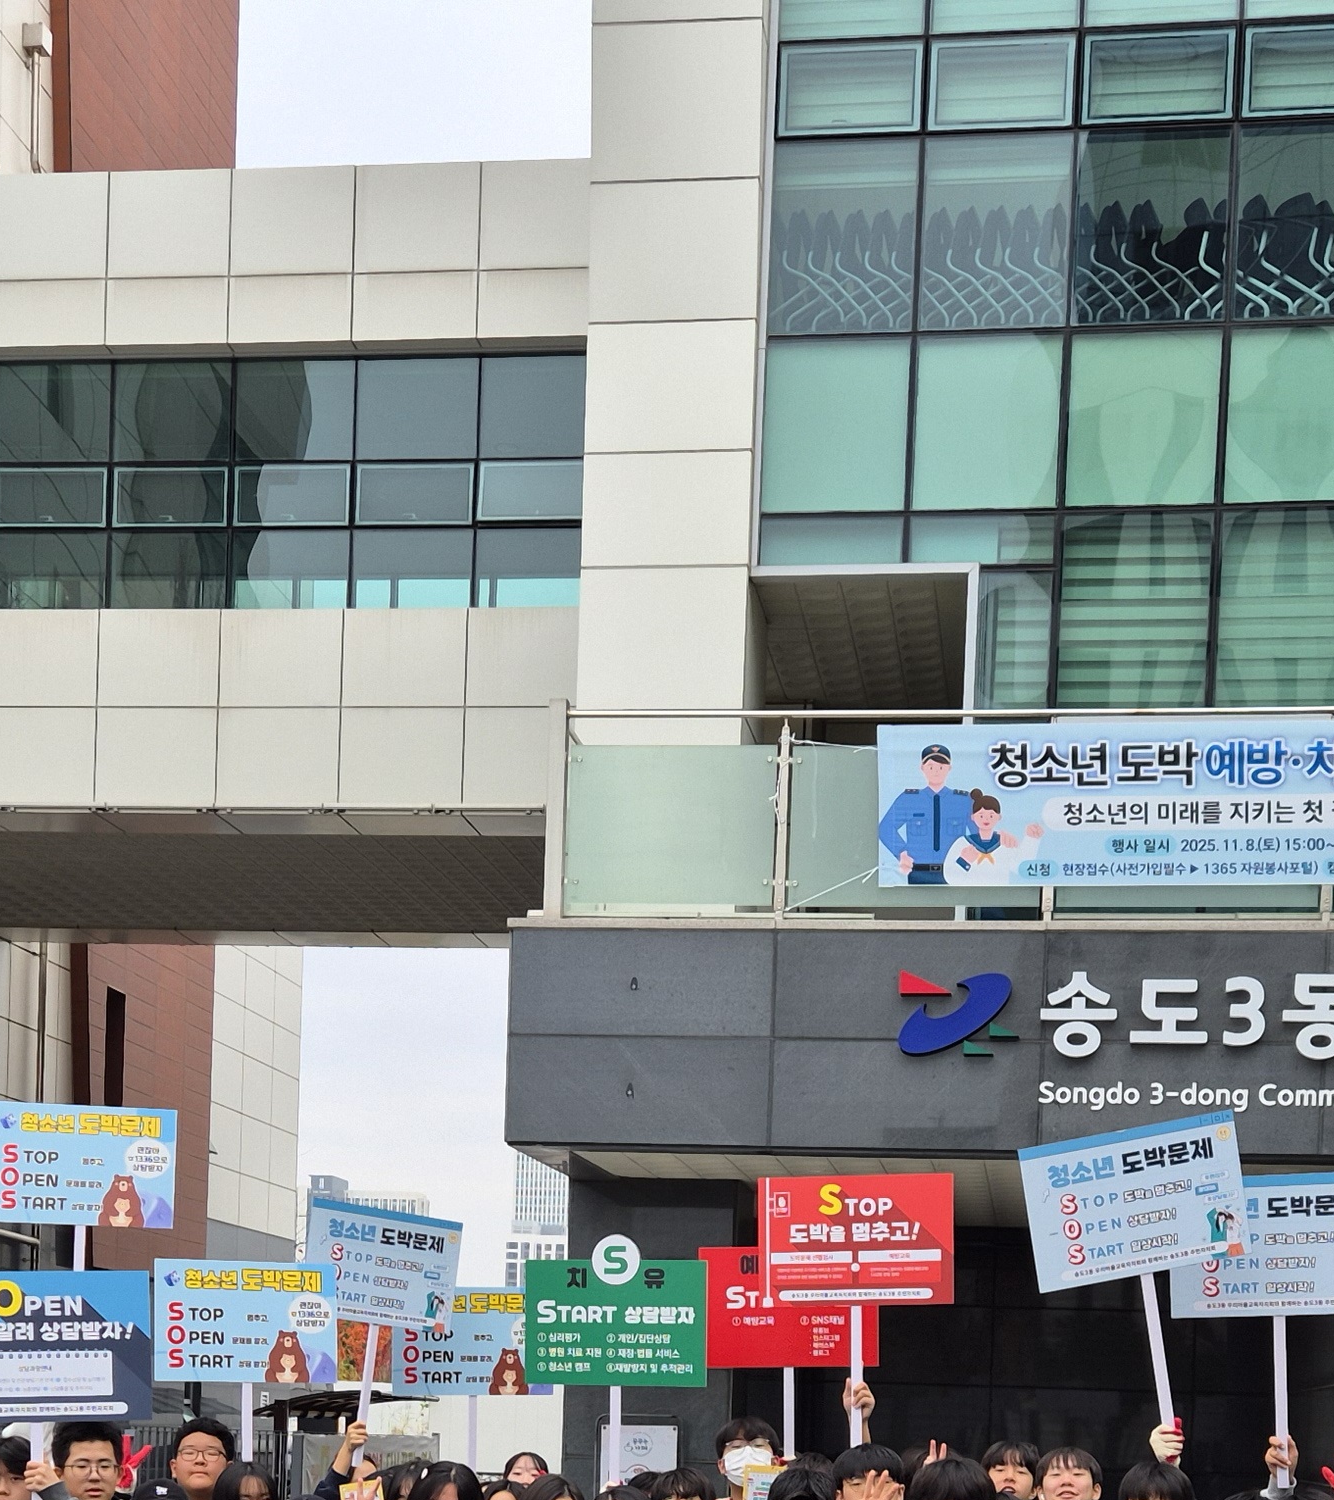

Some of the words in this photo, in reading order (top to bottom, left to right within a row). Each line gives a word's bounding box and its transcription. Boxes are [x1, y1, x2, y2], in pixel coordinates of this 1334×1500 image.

[990, 742, 1108, 788] 청소년
[1116, 741, 1203, 786] 도박
[1063, 801, 1149, 826] 청소년의
[1157, 800, 1223, 825] 미래를
[1229, 800, 1296, 824] 지키는
[1302, 799, 1323, 823] 첫
[1111, 838, 1139, 854] 행사
[1143, 838, 1170, 854] 일시
[1026, 863, 1051, 877] 신청
[1204, 862, 1238, 875] 1365
[1038, 1081, 1140, 1111] Songdo
[1149, 1082, 1248, 1112] 3-dong
[20, 1111, 75, 1133] 청소년
[78, 1113, 161, 1138] 도박문제
[1048, 1155, 1115, 1189] 청소년
[1121, 1137, 1214, 1175] 도박문제
[819, 1184, 893, 1216] STOP
[789, 1224, 846, 1243] 도박을
[852, 1222, 920, 1242] 멈추고!
[185, 1269, 238, 1289] 청소년
[242, 1269, 322, 1292] 도박문제
[537, 1300, 617, 1324] START
[625, 1306, 695, 1324] 상담받자
[40, 1322, 134, 1341] 상담받자!
